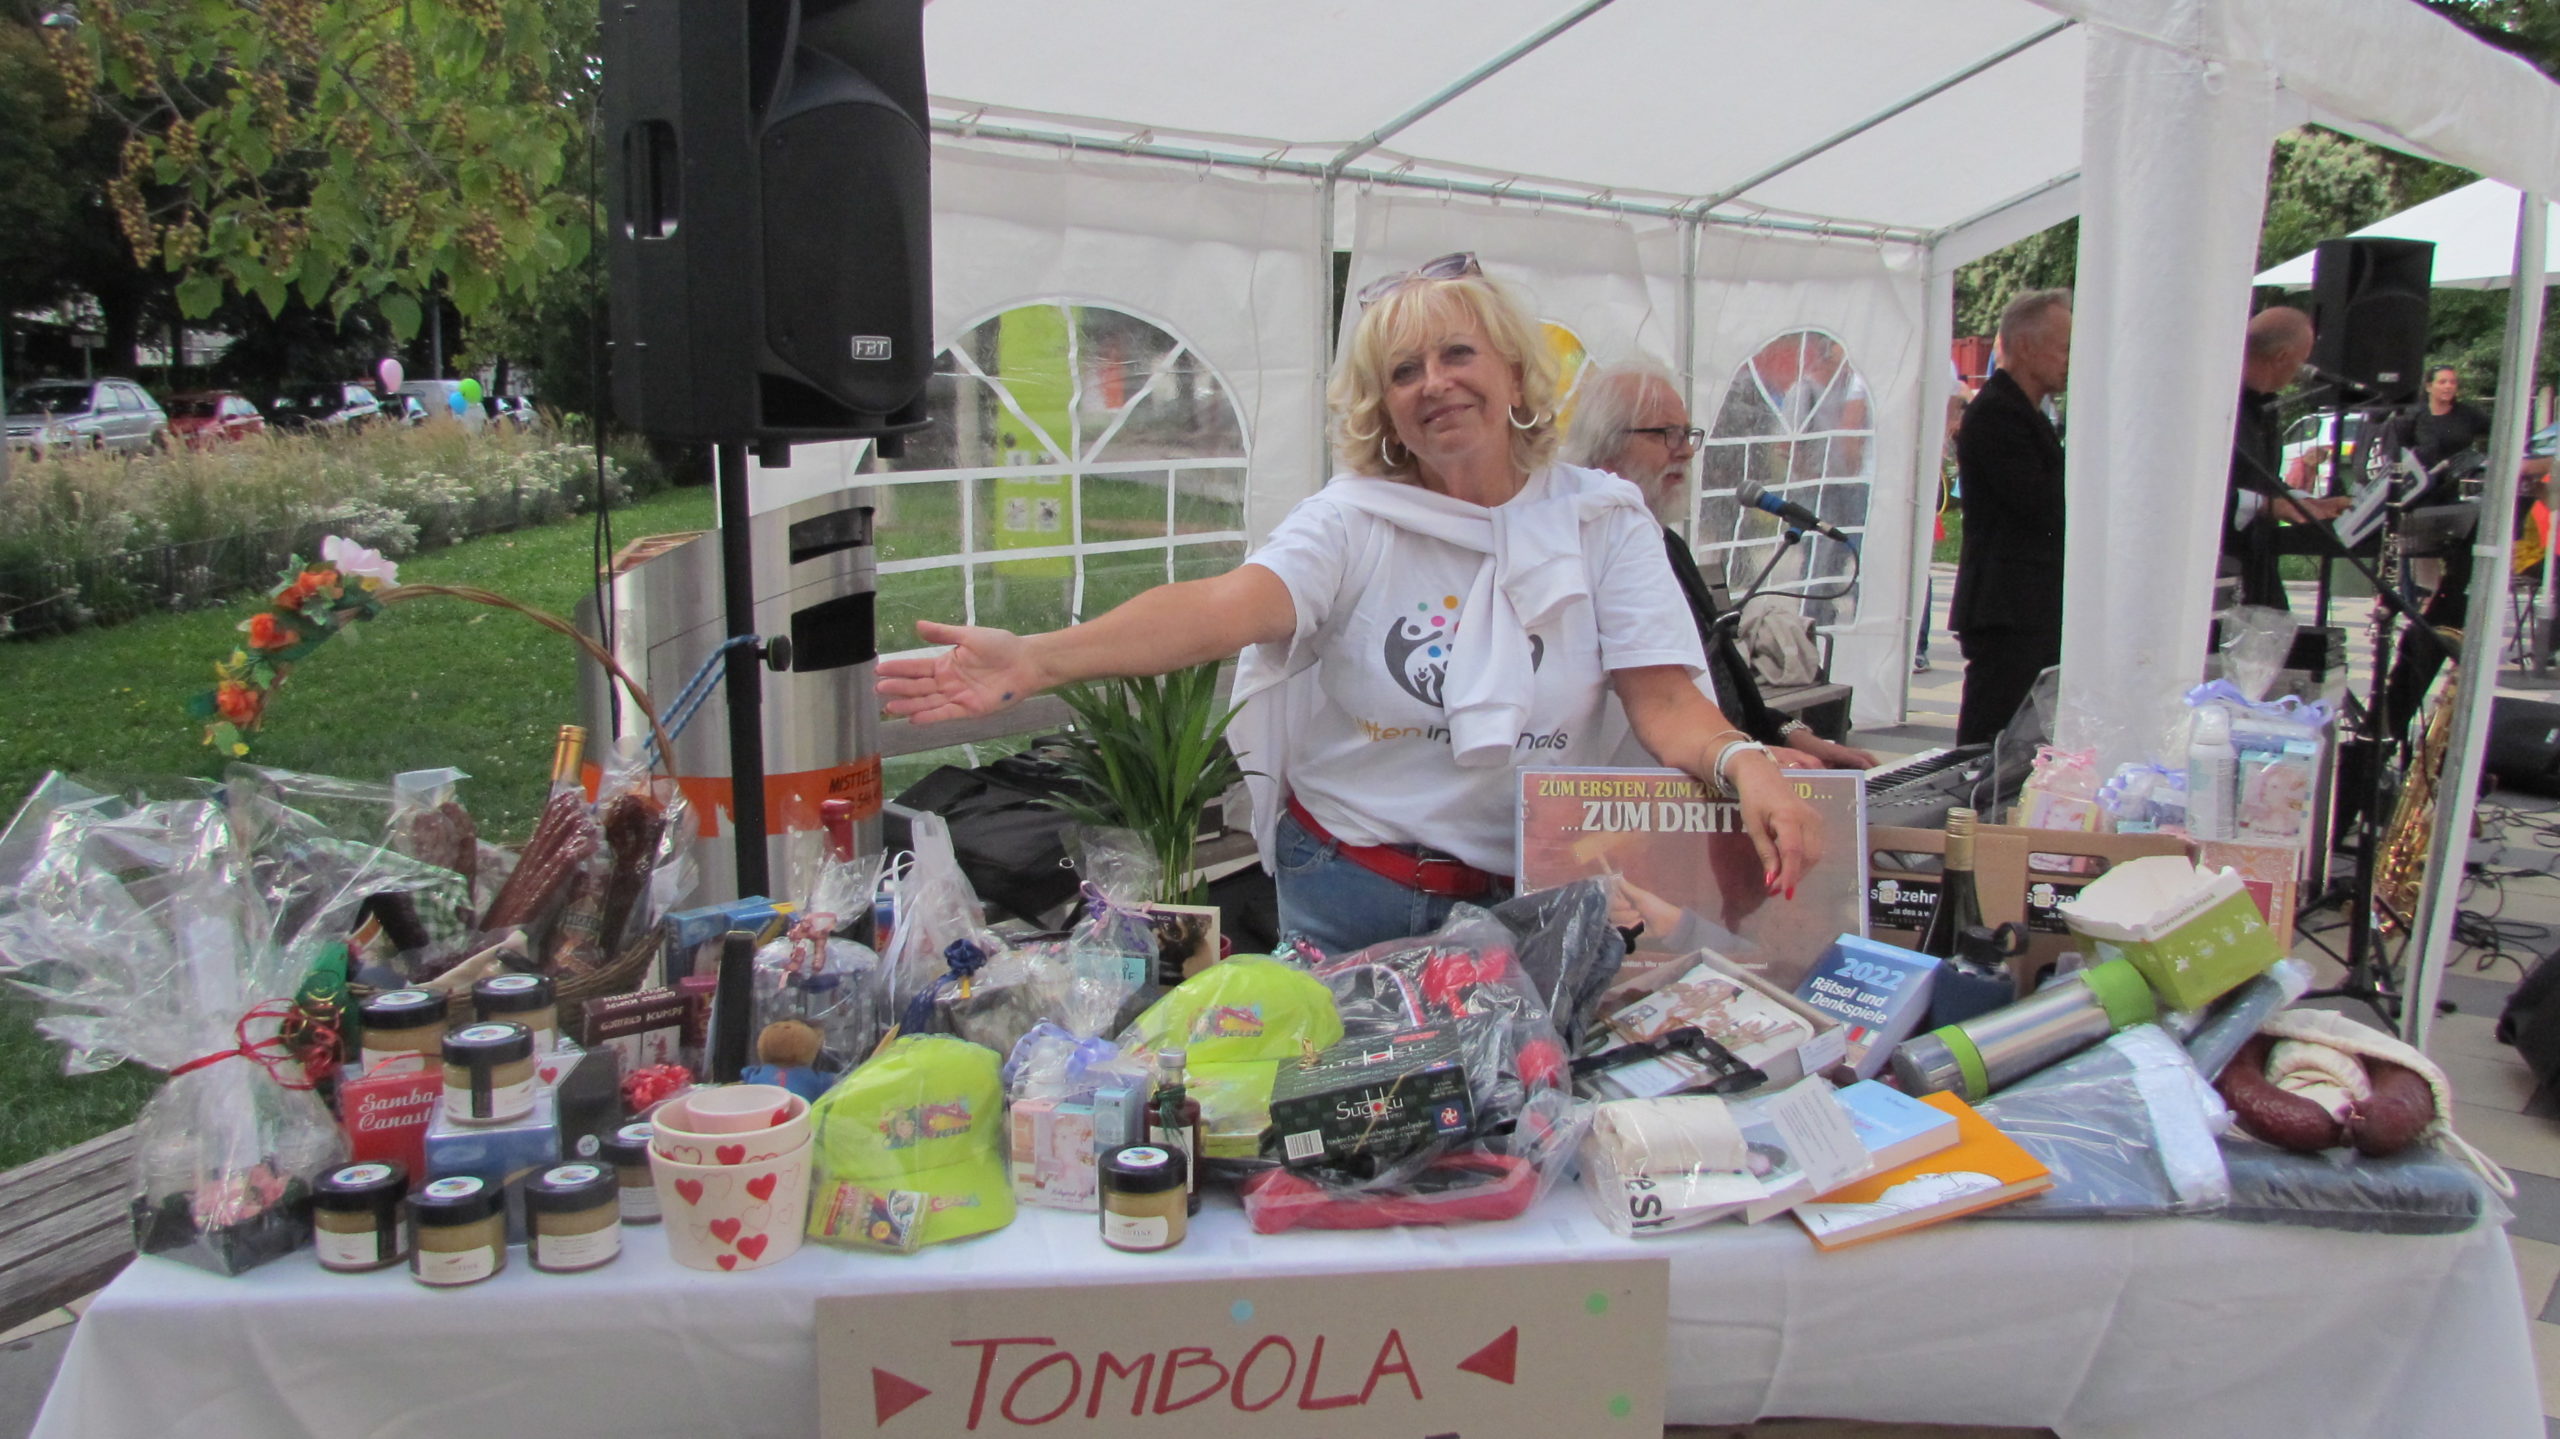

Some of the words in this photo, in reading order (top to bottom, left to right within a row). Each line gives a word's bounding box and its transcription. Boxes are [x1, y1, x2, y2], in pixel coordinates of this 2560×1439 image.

[855, 340, 888, 356] FBT
[1515, 729, 1568, 750] nals
[1538, 779, 1575, 798] ZUM
[1580, 780, 1650, 798] ERSTEN,
[1655, 782, 1691, 798] ZUM
[1658, 802, 1749, 833] DRIT
[1834, 957, 1906, 991] 2022
[1810, 976, 1858, 999] Rätsel
[1855, 992, 1888, 1009] und
[1808, 991, 1888, 1025] Denkspiele
[358, 1087, 434, 1114] Samba
[359, 1106, 432, 1132] Canast
[951, 1328, 1424, 1431] TOMBOLA
